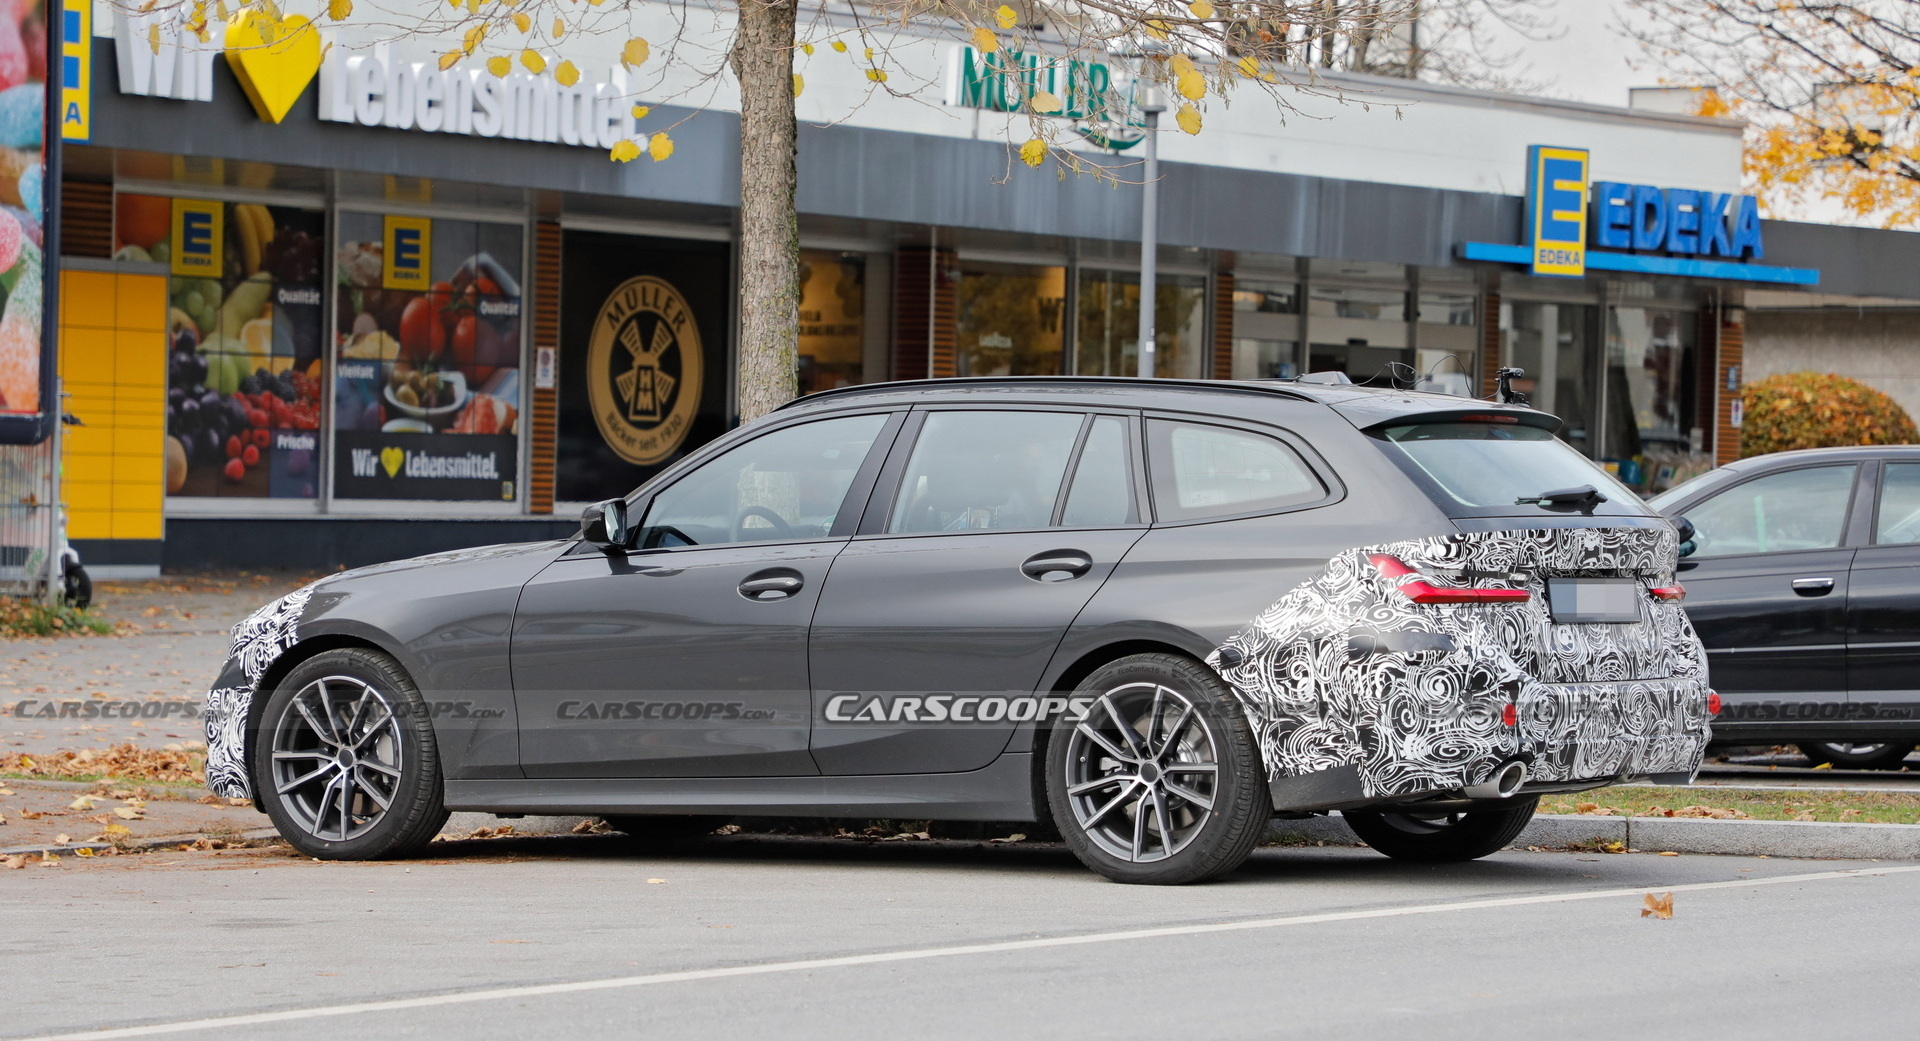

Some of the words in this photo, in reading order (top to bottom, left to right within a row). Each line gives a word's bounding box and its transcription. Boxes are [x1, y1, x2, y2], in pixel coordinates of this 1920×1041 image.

[112, 0, 223, 102] Wir
[1541, 157, 1583, 243] E
[1594, 181, 1764, 259] EDEKA
[184, 211, 212, 255] E
[395, 228, 420, 269] E
[1539, 249, 1580, 265] EDEKA
[277, 434, 315, 451] Frische
[352, 448, 378, 477] Wir
[405, 450, 499, 480] Lebensmittel.
